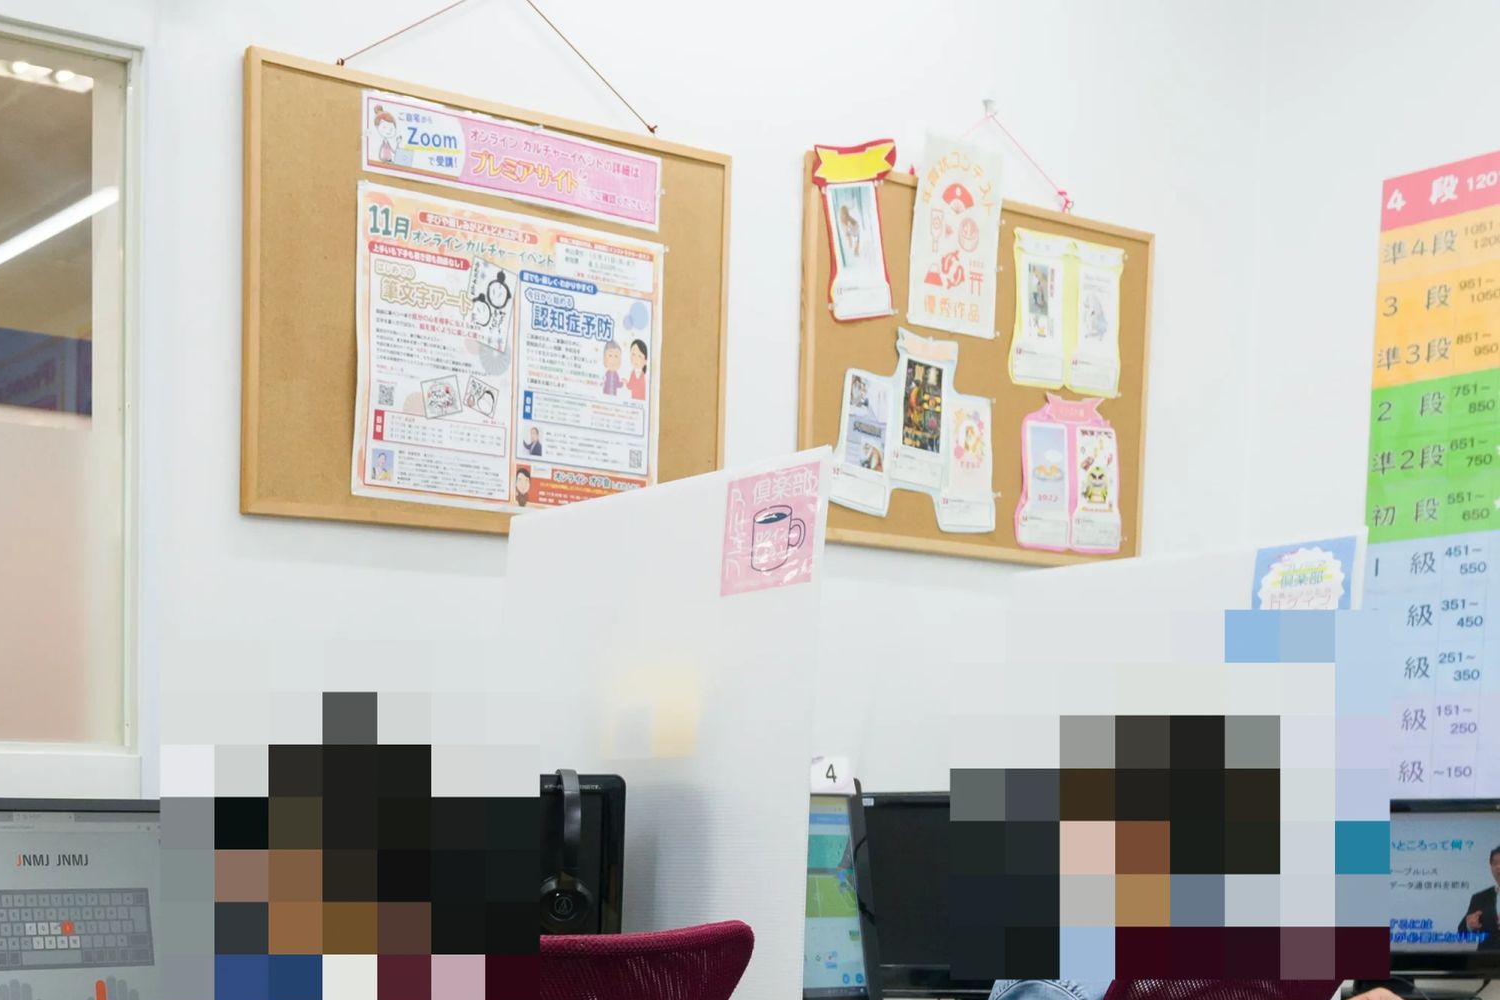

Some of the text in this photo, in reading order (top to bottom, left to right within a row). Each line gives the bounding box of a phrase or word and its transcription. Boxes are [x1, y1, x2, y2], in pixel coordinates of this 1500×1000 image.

[407, 126, 458, 149] Zoom
[471, 150, 579, 194] プレミアサイト
[1466, 170, 1500, 192] 120
[1386, 174, 1459, 212] 4 段
[369, 204, 410, 240] 11月
[1464, 220, 1500, 237] 1051
[1383, 228, 1458, 265] 準4段
[381, 279, 474, 313] 筆文字アート
[1383, 284, 1451, 318] 3 段
[533, 304, 612, 340] 認知症予防
[1376, 336, 1452, 371] 準3段
[1474, 342, 1499, 358] 950
[1377, 390, 1445, 422] 2 段
[1468, 398, 1496, 415] 850
[1372, 443, 1445, 475] 準2段
[1465, 453, 1493, 468] 750
[1372, 497, 1440, 528] 初 段
[1461, 507, 1490, 522] 650
[1410, 550, 1436, 575] 級
[1459, 561, 1488, 575] 550
[1406, 602, 1433, 627] 級
[1456, 614, 1484, 628] 450
[1403, 655, 1430, 680] 級
[1453, 668, 1481, 682] 350
[1400, 707, 1427, 732] 級
[1450, 720, 1478, 735] 250
[825, 763, 837, 783] 4
[1398, 759, 1425, 784] 級
[16, 853, 89, 867] JNMJ JNMJ
[1390, 867, 1438, 876] ーブルレス
